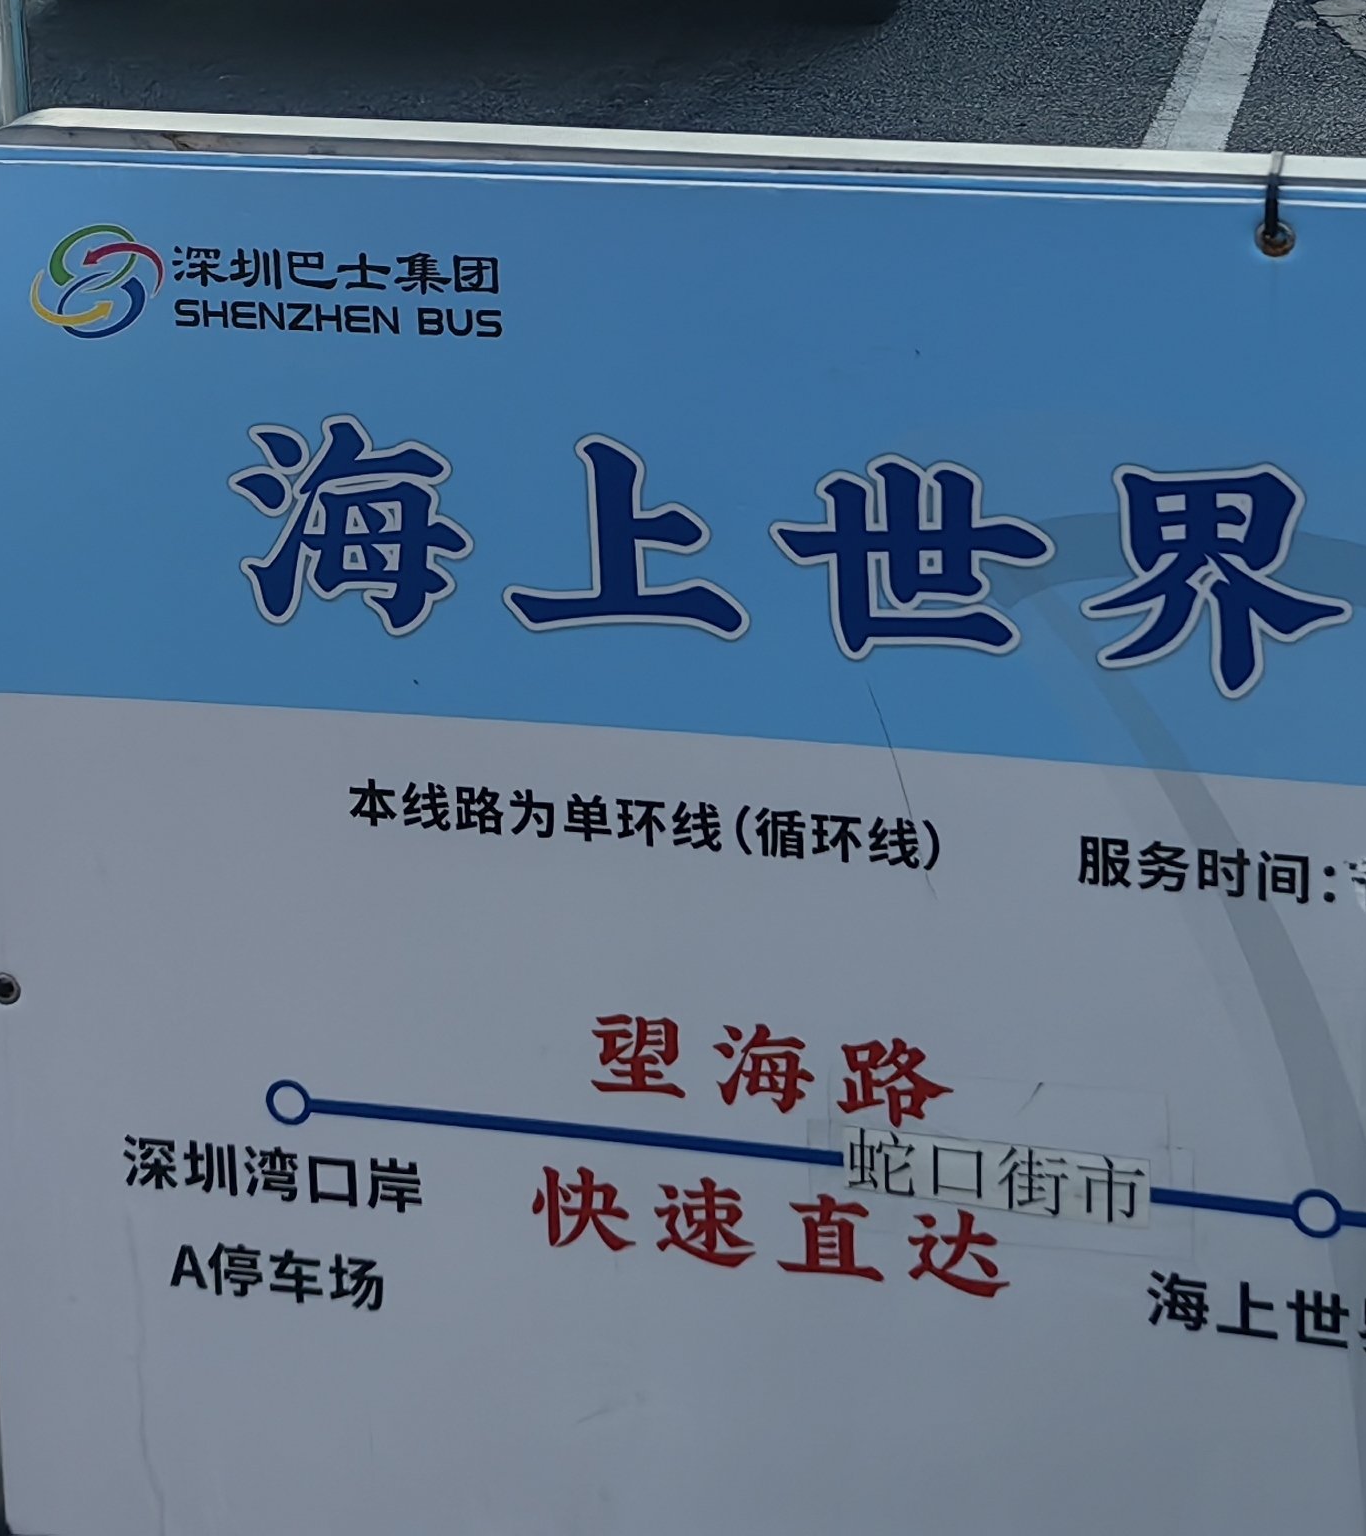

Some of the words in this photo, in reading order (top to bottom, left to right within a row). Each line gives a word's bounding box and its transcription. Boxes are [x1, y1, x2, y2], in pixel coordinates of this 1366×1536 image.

[171, 245, 500, 296] 深圳巴士集团
[174, 299, 401, 335] SHENZHEN
[417, 307, 503, 339] BUS
[347, 778, 942, 872] 本线路为单环线(循环线)
[1077, 834, 1338, 905] 服务时间:
[590, 1013, 955, 1128] 望海路
[123, 1134, 424, 1214] 深圳湾口岸
[847, 1127, 1146, 1224] 蛇口街市
[531, 1165, 1012, 1298] 快速直达
[169, 1241, 385, 1312] A停车场
